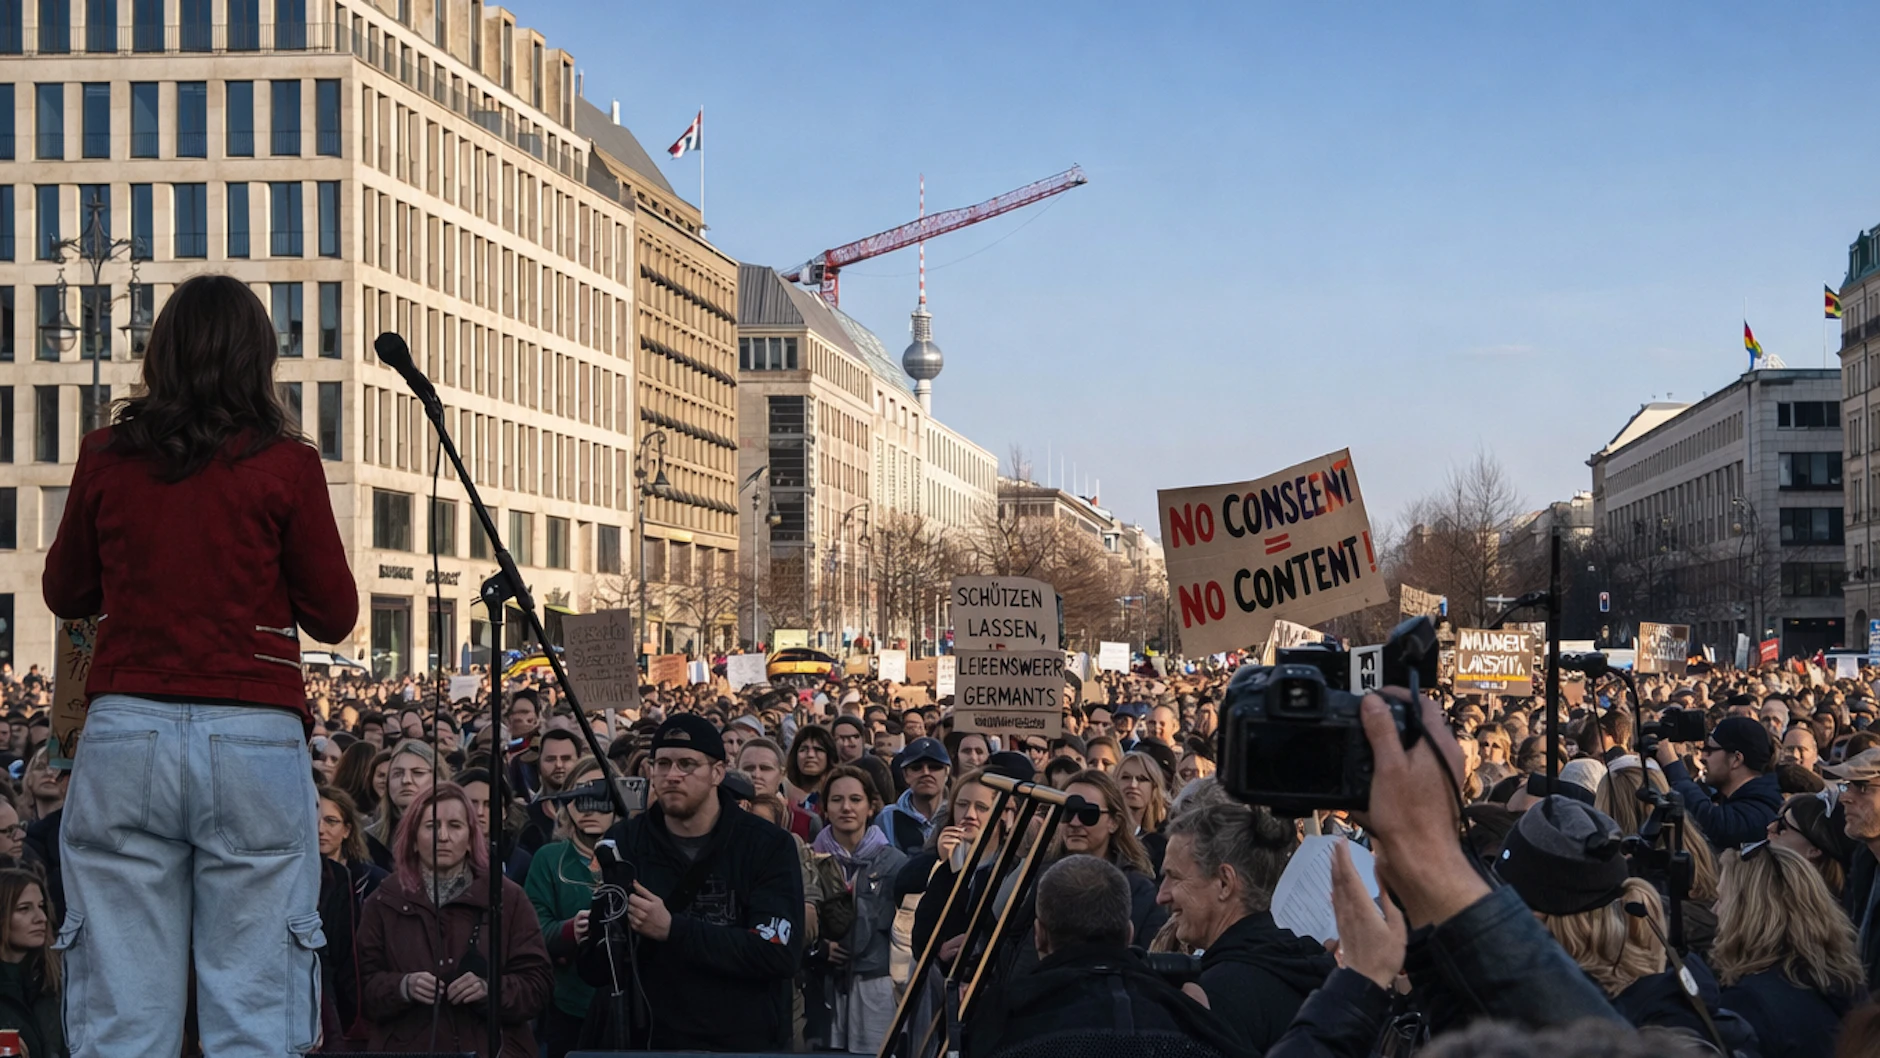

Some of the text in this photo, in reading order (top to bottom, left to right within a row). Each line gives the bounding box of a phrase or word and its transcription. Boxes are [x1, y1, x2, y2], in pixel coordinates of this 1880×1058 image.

[1169, 457, 1355, 548] NO CONSEENT
[957, 581, 1042, 608] SCHÜTZEN
[1178, 580, 1226, 629] NO
[968, 618, 1046, 645] LASSEN,
[963, 686, 1056, 707] GERMANTS
